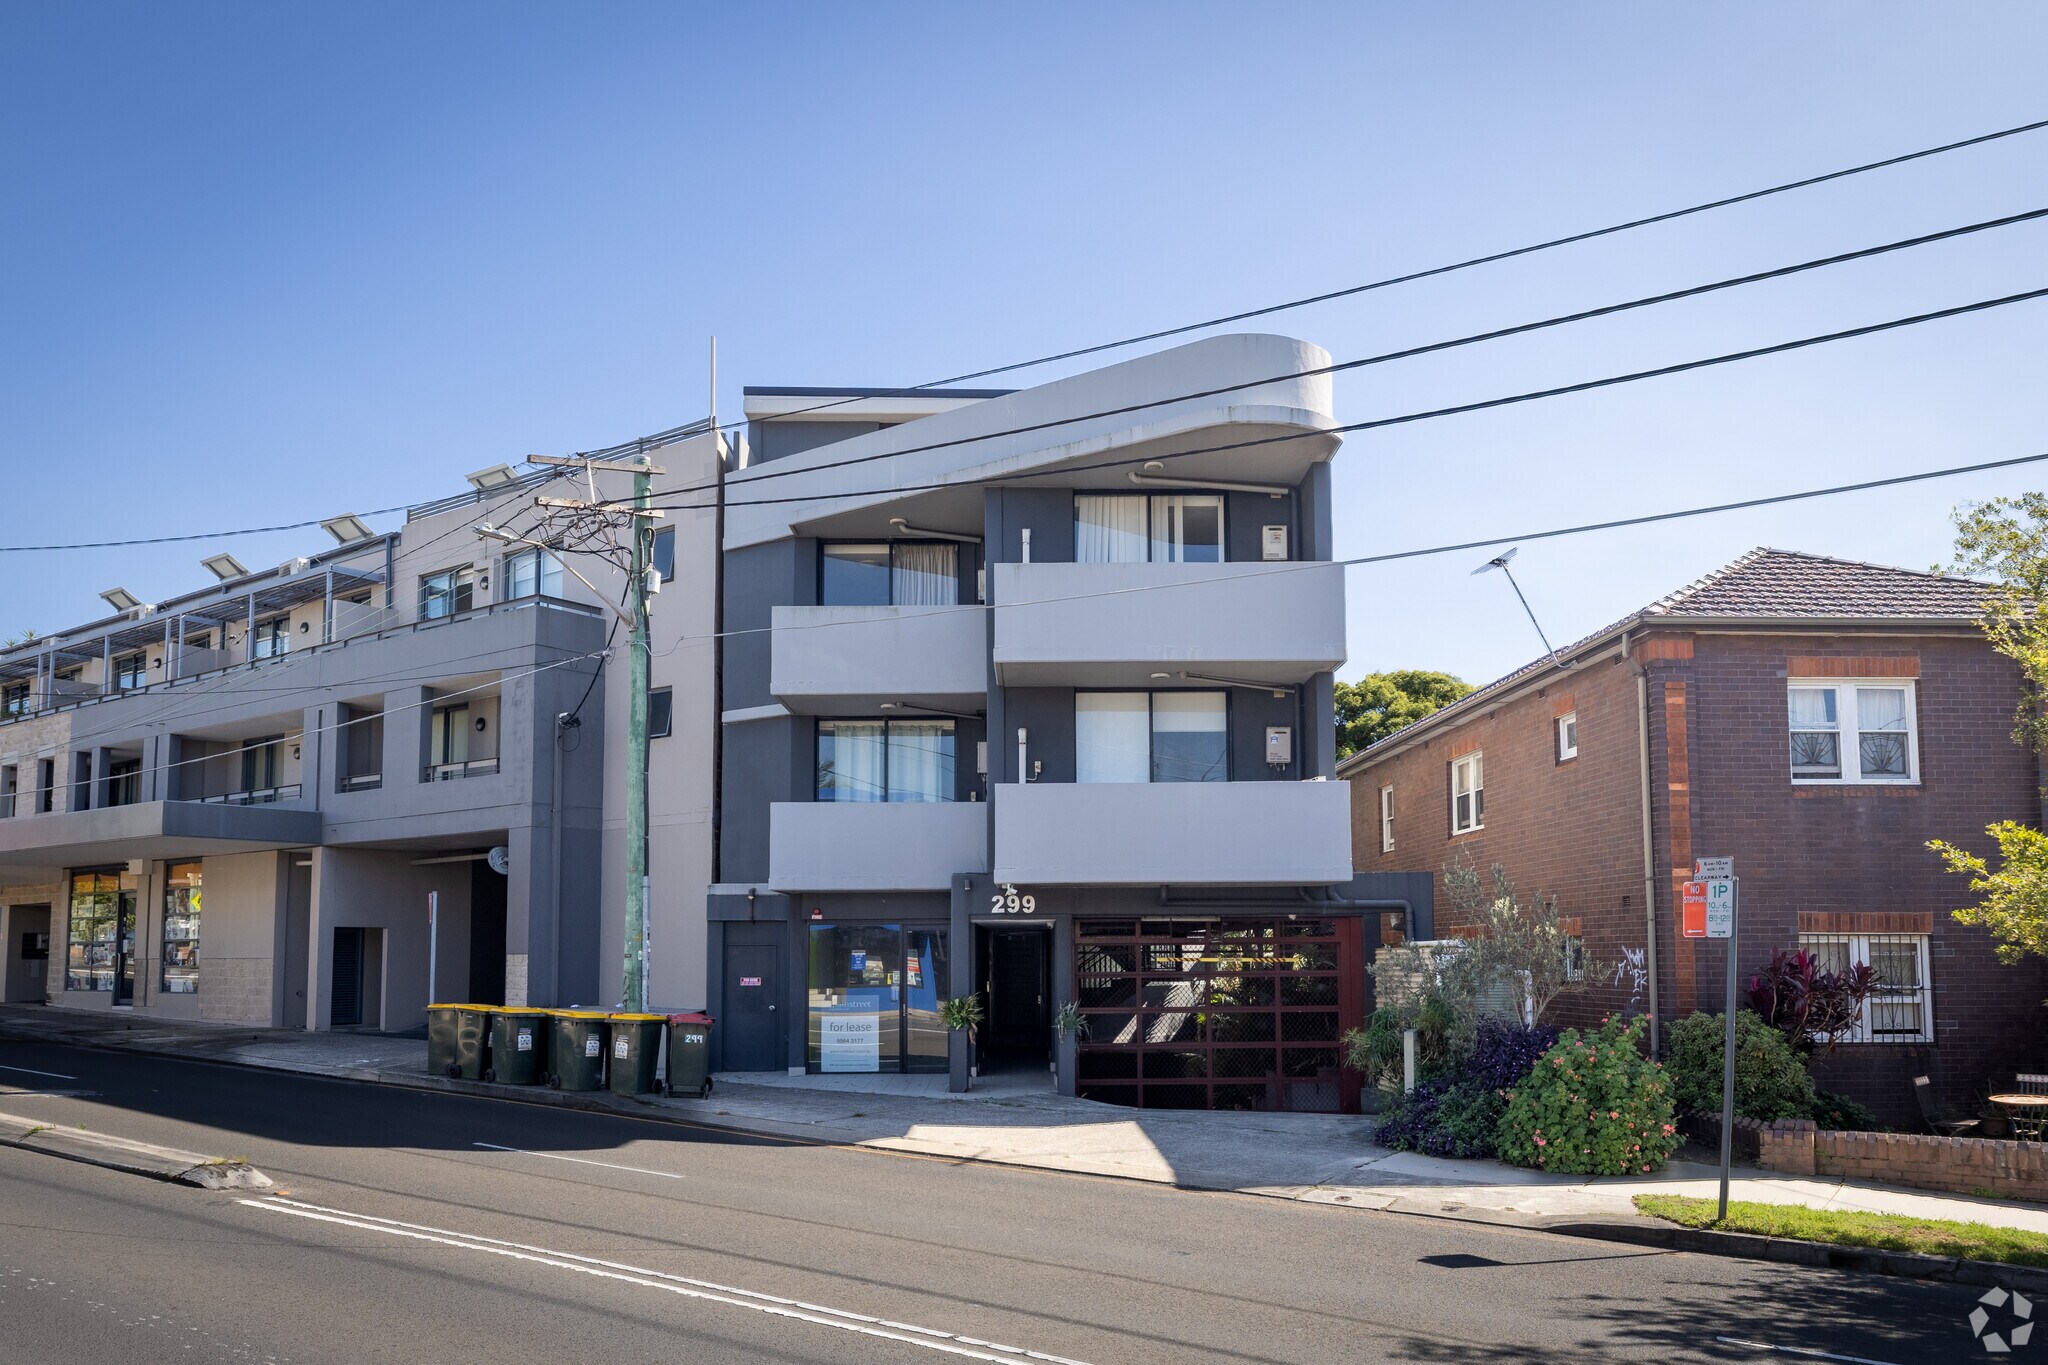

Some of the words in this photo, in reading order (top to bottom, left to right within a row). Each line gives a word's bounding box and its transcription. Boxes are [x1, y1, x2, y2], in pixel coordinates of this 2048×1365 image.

[1690, 885, 1700, 894] NO
[1713, 885, 1728, 898] 1P
[991, 894, 1036, 914] 299
[1684, 896, 1706, 904] STOPPING
[829, 1022, 844, 1032] for
[846, 1022, 872, 1032] lease
[685, 1034, 703, 1044] 299
